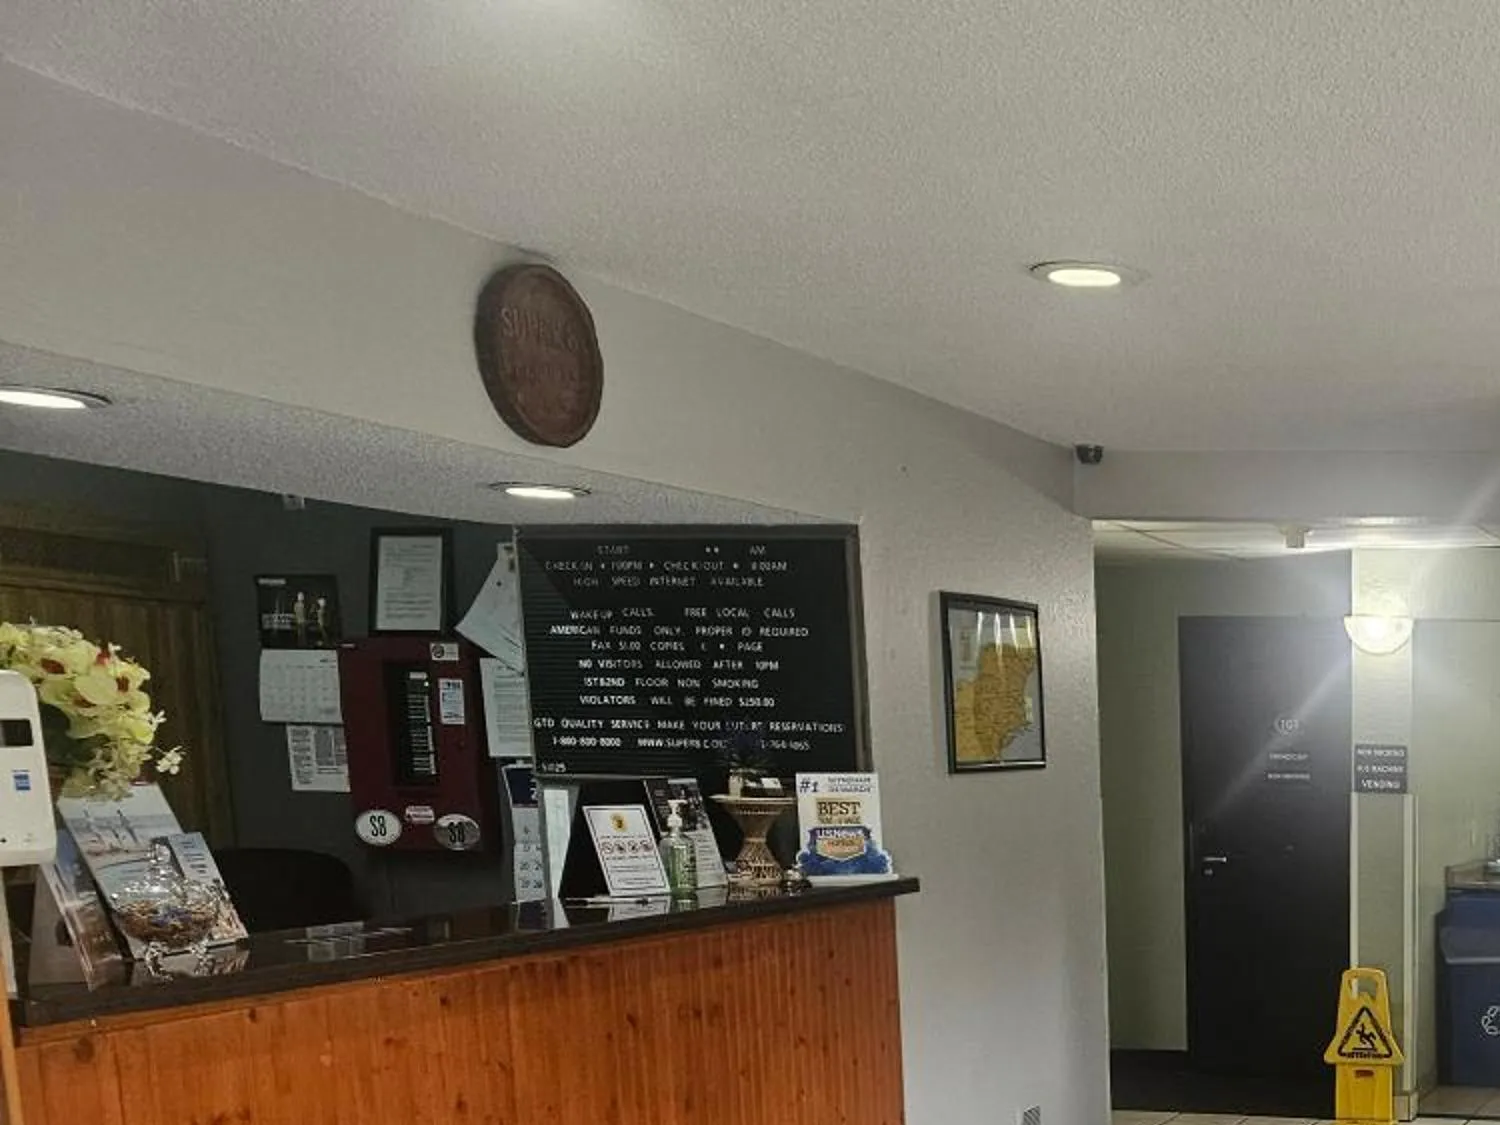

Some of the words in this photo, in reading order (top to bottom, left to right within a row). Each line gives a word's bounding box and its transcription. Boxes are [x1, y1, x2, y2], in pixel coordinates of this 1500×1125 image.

[763, 607, 796, 618] CALLS
[550, 625, 600, 635] AMERICAN
[609, 625, 642, 635] FUNDS
[695, 625, 733, 636] PROPER
[759, 627, 809, 637] REQUIRED
[597, 659, 643, 669] VISITORS
[655, 659, 701, 669] ALLOWED
[713, 660, 743, 669] AFTER
[635, 677, 669, 687] FLOOR
[712, 678, 759, 689] SMOKING
[579, 695, 636, 705] VIOLATORS
[651, 696, 673, 705] WILL
[561, 718, 603, 729] QUALITY
[657, 720, 685, 729] MAKE
[692, 720, 721, 731] YOUR
[769, 720, 844, 733] RESERVATIONS
[800, 781, 818, 793] #1
[817, 801, 861, 815] BEST
